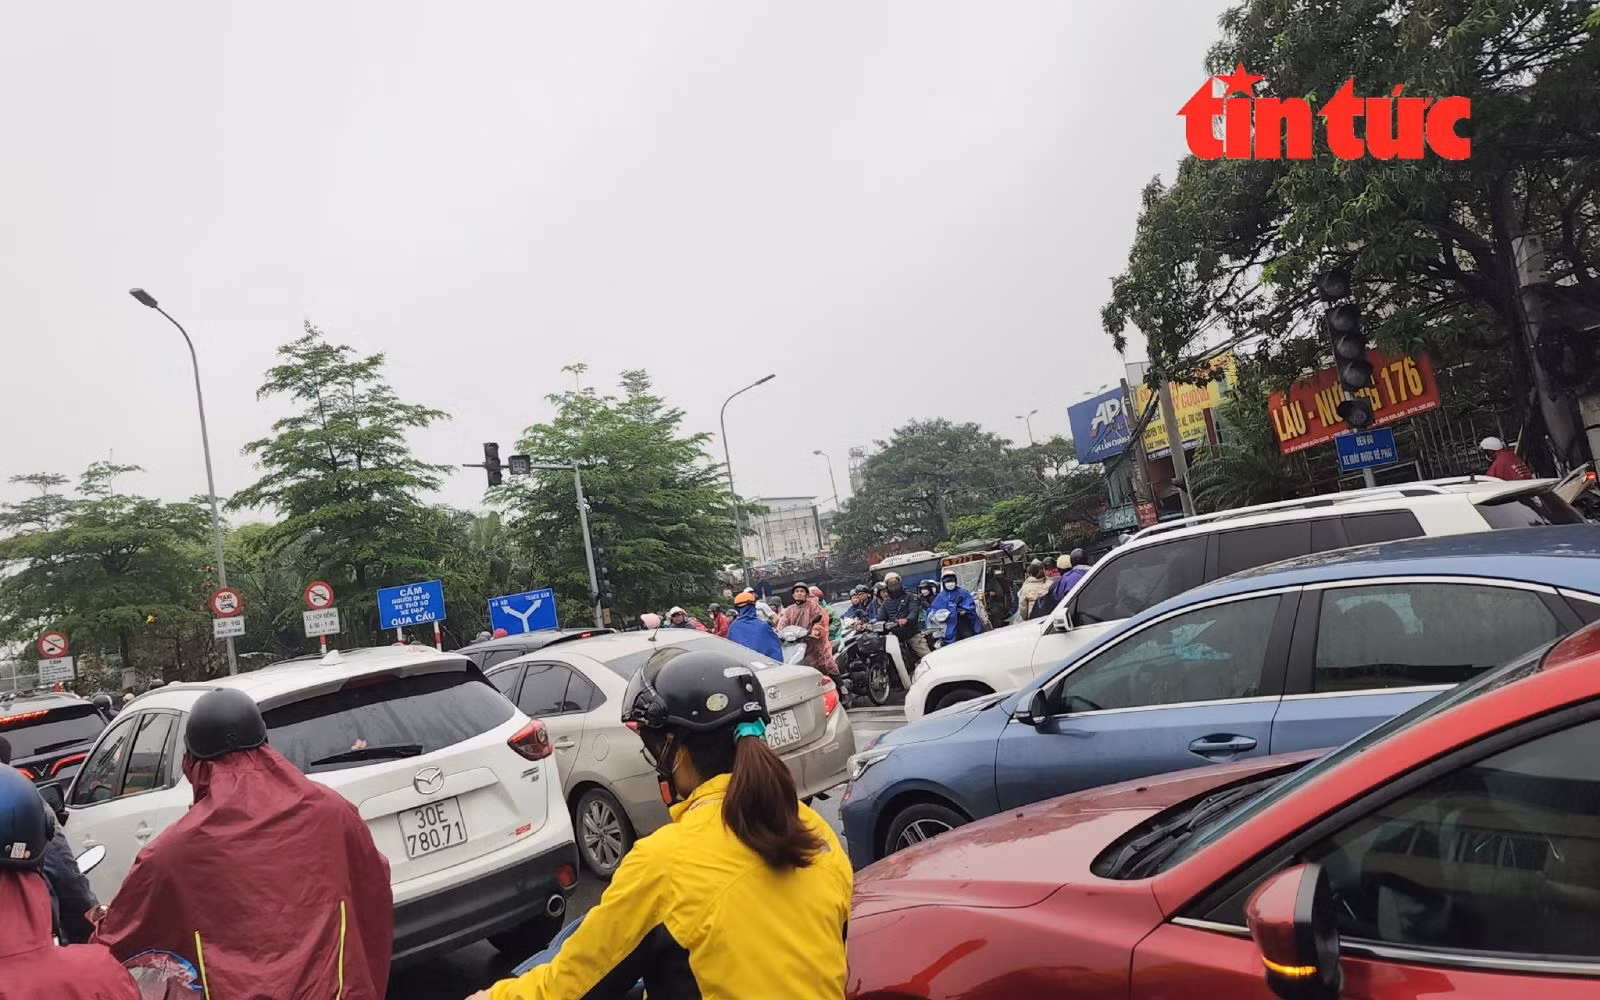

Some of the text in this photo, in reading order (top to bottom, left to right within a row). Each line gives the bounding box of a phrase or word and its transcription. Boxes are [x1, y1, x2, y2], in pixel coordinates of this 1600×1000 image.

[1381, 355, 1423, 405] 176
[391, 616, 413, 626] QUA
[770, 712, 789, 730] 30E
[768, 726, 800, 748] 264.49
[415, 803, 448, 829] 30E
[407, 821, 463, 855] 780.71
